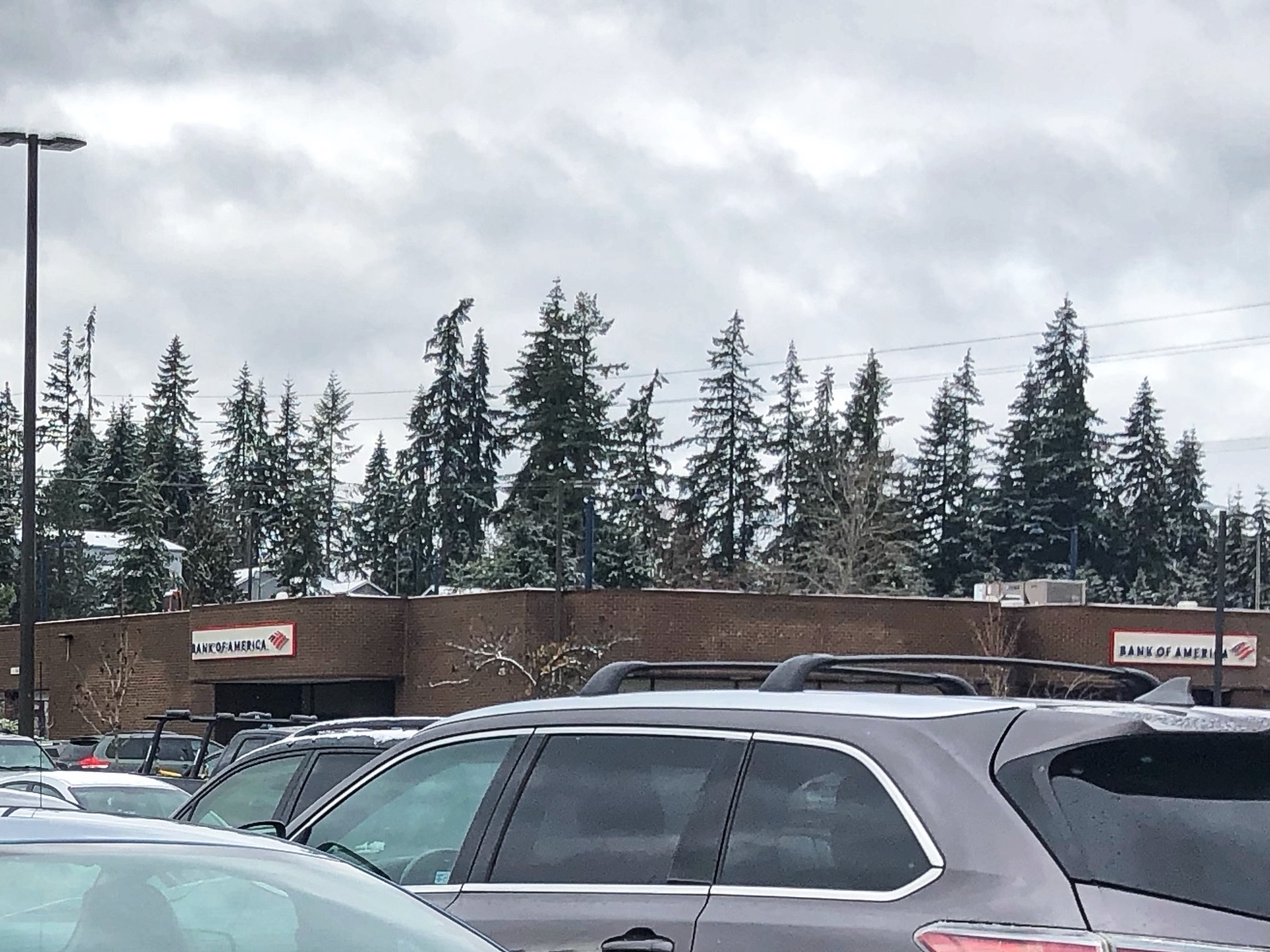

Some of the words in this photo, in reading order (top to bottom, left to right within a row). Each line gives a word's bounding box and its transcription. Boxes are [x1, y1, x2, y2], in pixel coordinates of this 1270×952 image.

[192, 643, 213, 654] BANK
[215, 642, 227, 653] OF
[228, 639, 266, 652] AMERICA
[1119, 645, 1154, 657] BANK
[1156, 646, 1172, 657] OF
[1174, 646, 1229, 660] AMERIA
